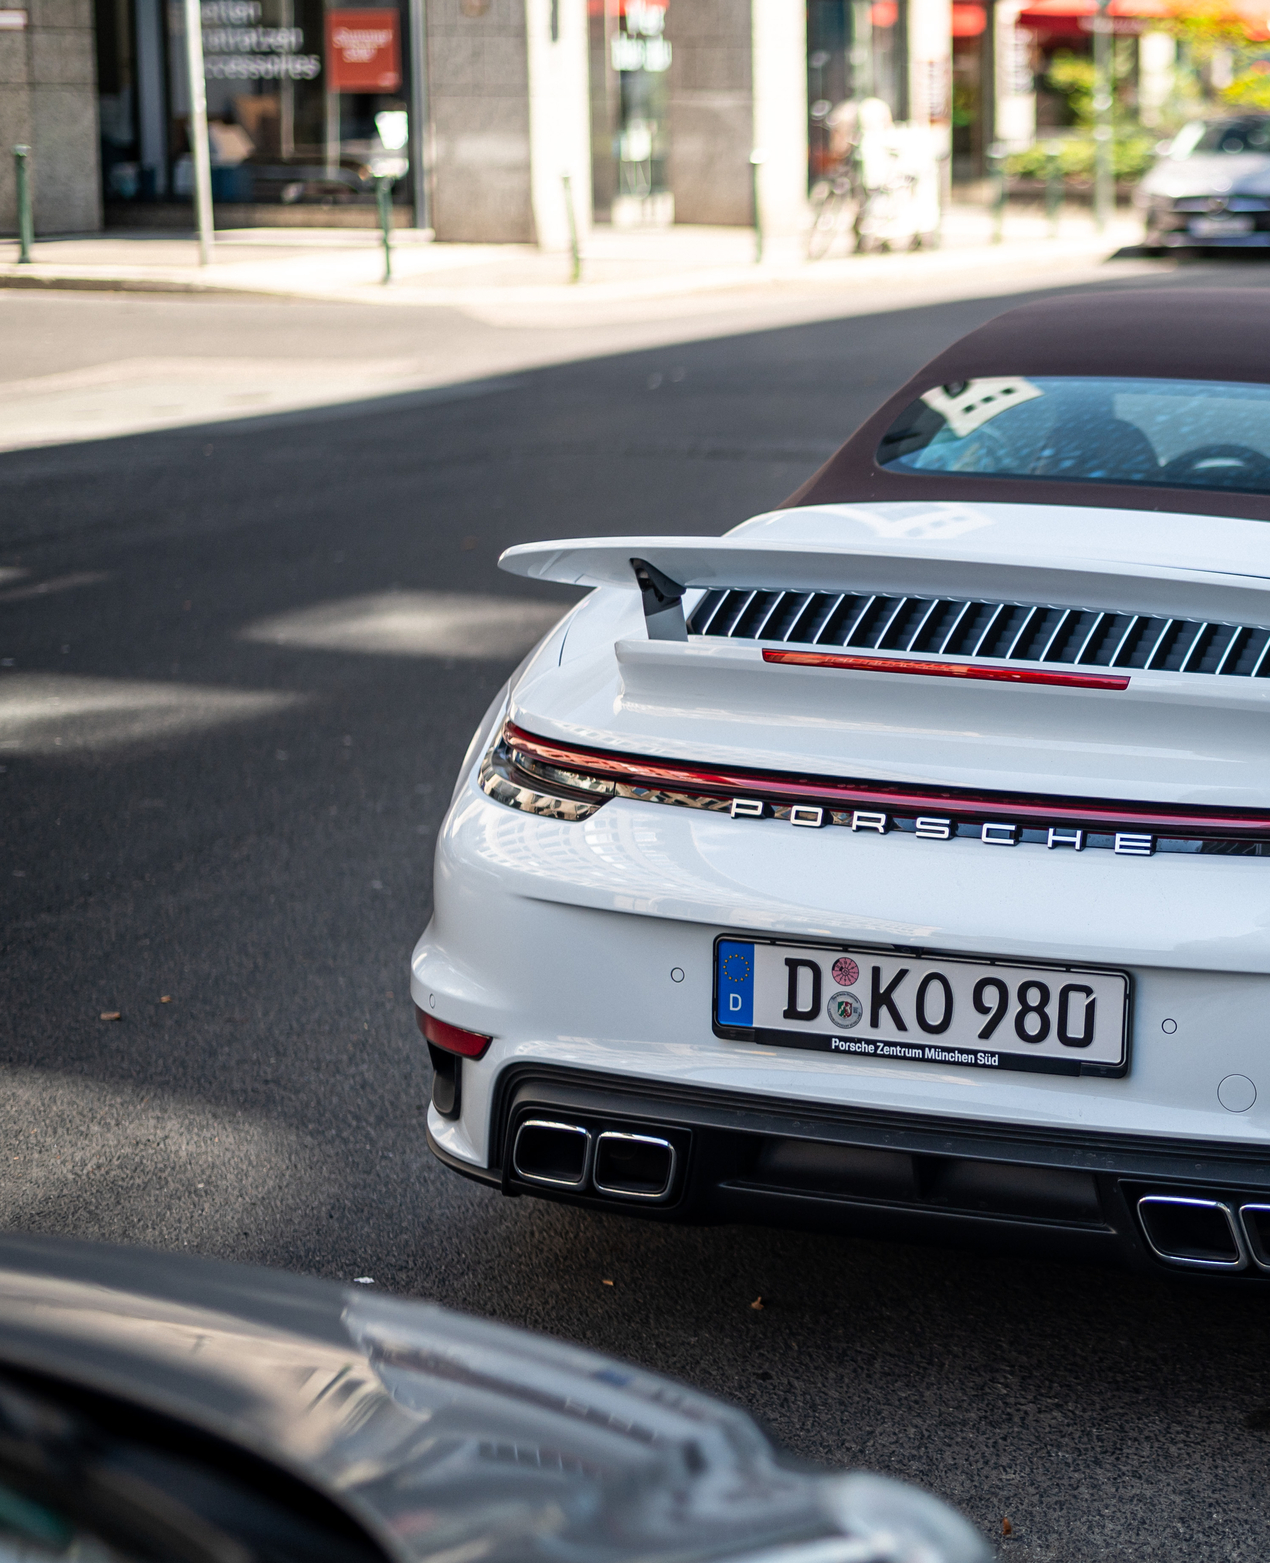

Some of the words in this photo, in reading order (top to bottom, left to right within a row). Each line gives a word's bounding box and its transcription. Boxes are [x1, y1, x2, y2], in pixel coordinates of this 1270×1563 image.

[203, 26, 303, 52] atratzen
[205, 54, 322, 80] ccessoires
[730, 797, 1155, 855] PORSCHE
[729, 993, 742, 1011] D
[783, 957, 822, 1021] D
[870, 965, 954, 1035] KO
[972, 976, 1096, 1049] 980
[832, 1038, 874, 1053] Porsche
[876, 1043, 923, 1058] Zentrum
[925, 1047, 975, 1063] München
[977, 1052, 999, 1065] Süd
